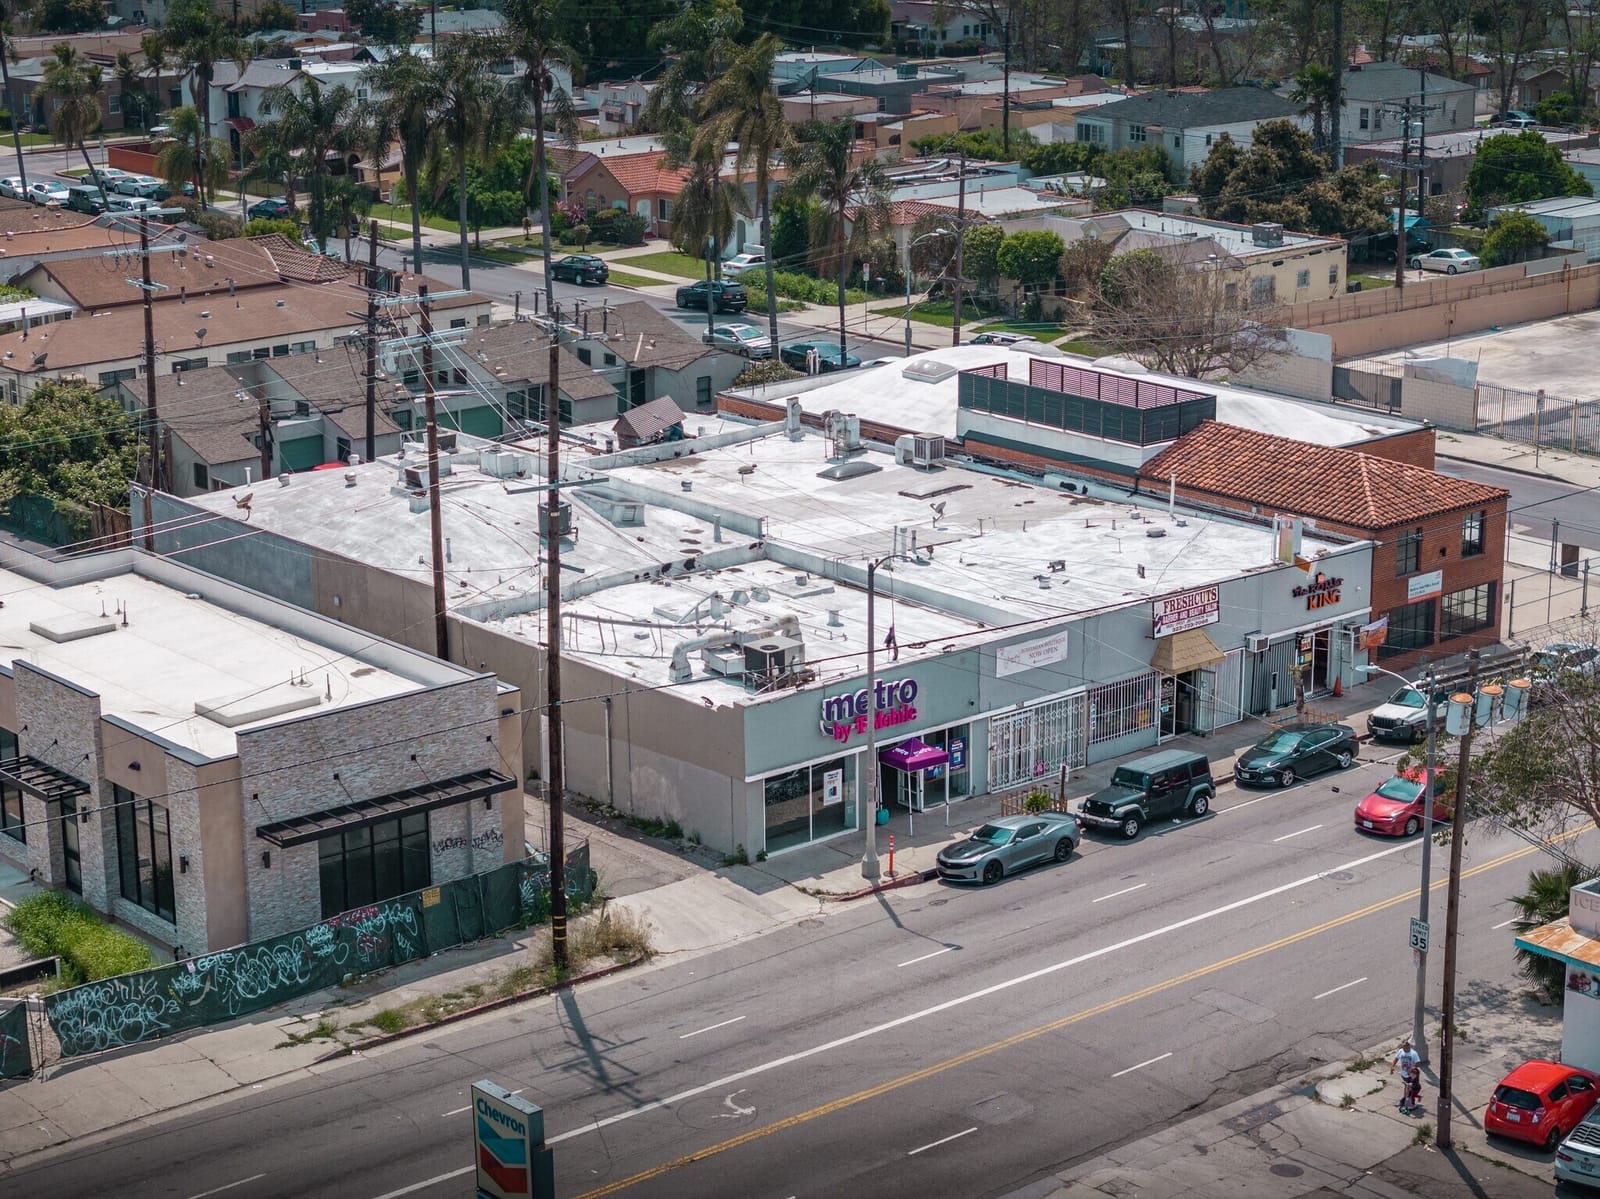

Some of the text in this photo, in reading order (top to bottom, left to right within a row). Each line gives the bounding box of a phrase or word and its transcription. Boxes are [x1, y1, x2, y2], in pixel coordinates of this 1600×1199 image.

[1163, 587, 1217, 613] FRESHCUTS
[1307, 588, 1342, 610] KING
[1179, 610, 1188, 620] AND
[1189, 606, 1204, 617] BEAUTY
[1029, 650, 1042, 659] NOW
[1043, 646, 1058, 655] OPEN
[823, 678, 918, 721] metro
[833, 722, 852, 744] by
[1411, 920, 1428, 931] SPEED
[1412, 927, 1427, 938] LIMIT
[1411, 934, 1427, 950] 35
[476, 1097, 526, 1137] Chevron
